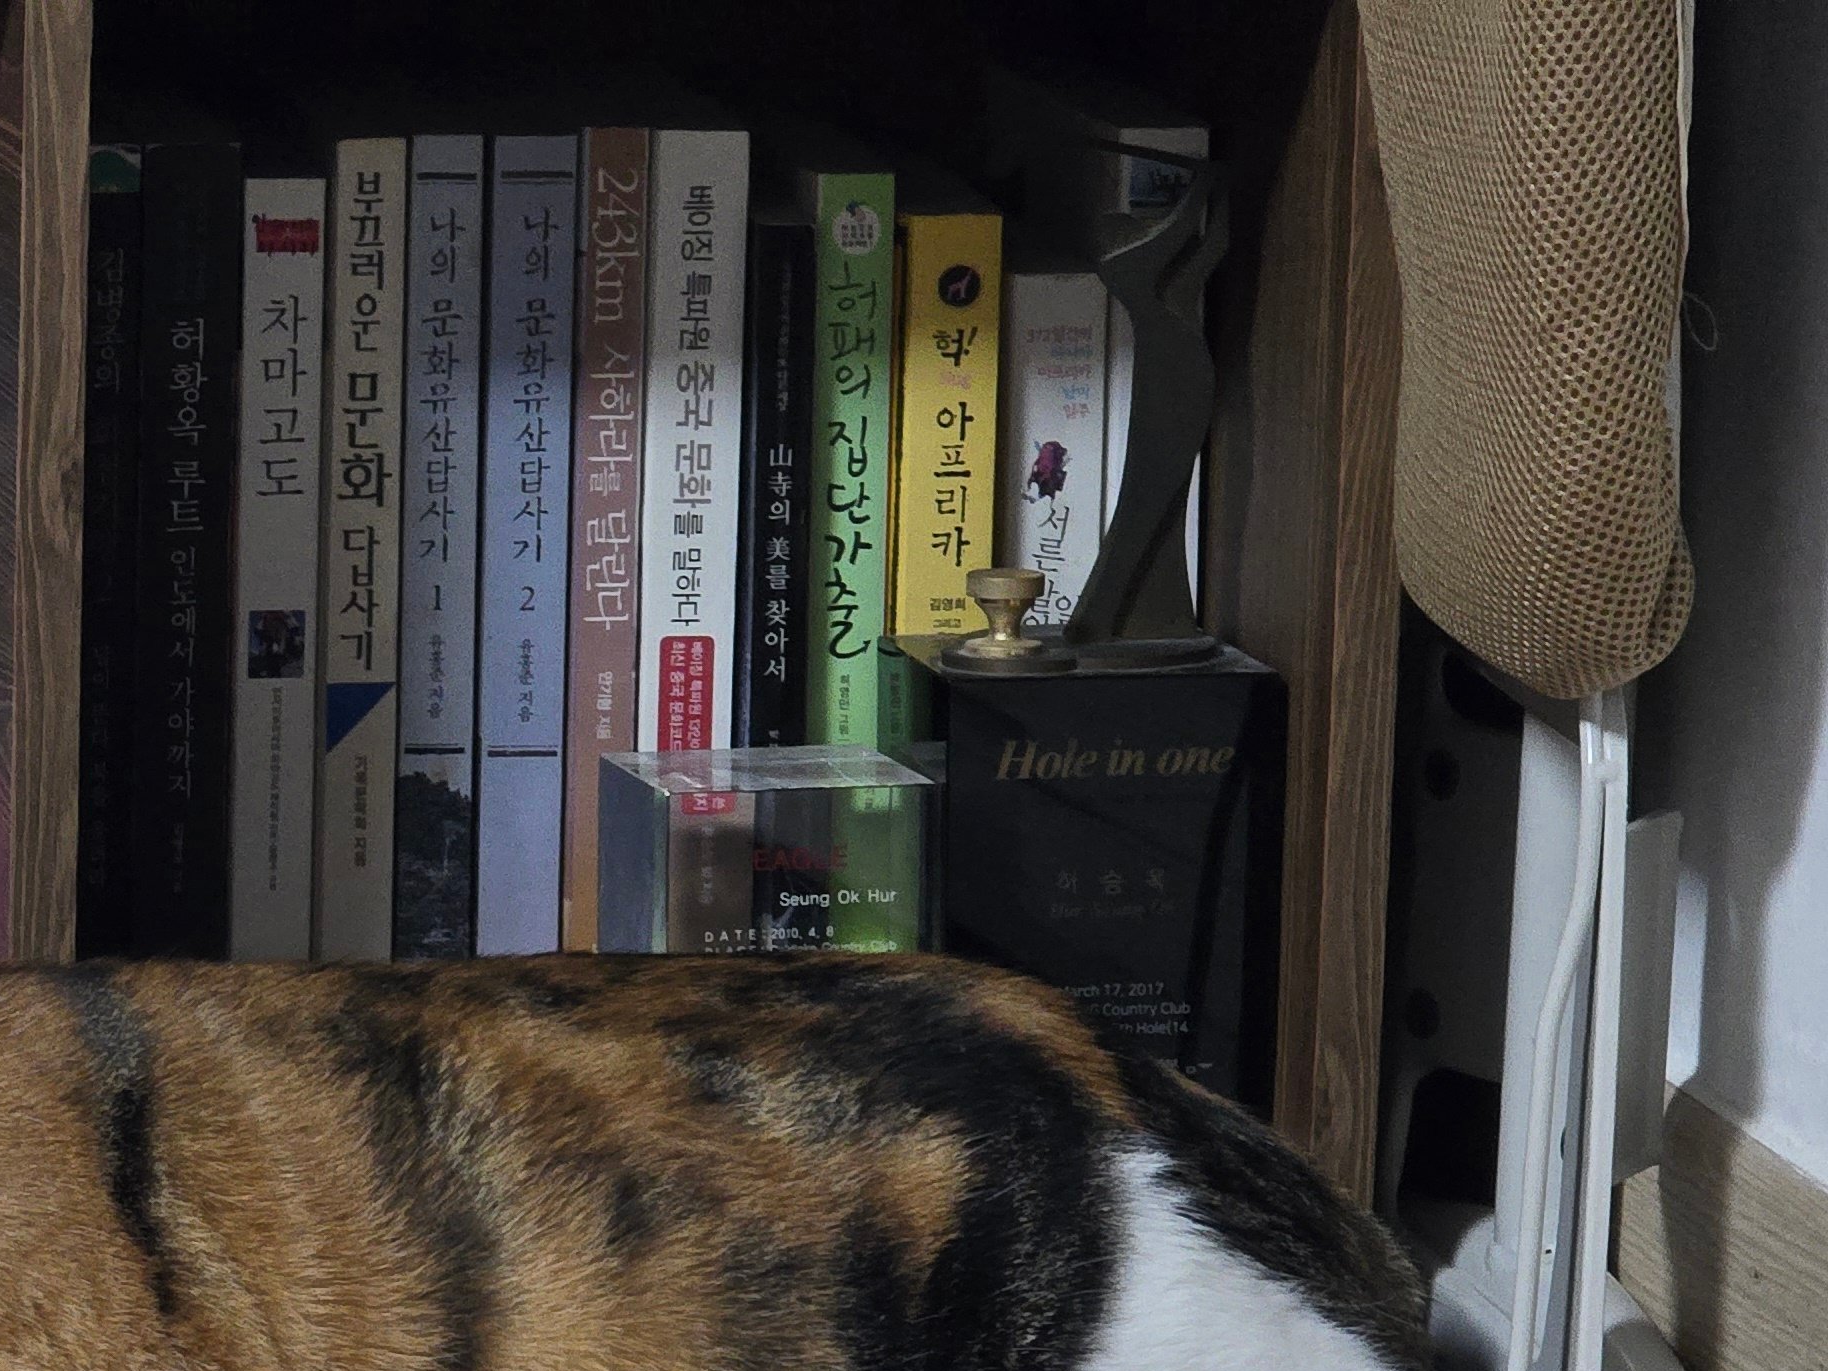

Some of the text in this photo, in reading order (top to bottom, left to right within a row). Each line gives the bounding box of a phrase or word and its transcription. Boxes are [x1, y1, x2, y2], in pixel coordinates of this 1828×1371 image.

[429, 207, 467, 284] 나의
[165, 317, 207, 533] 허황옥 루트
[256, 294, 309, 498] 차마고도
[336, 171, 394, 671] 부끄러운 문화 답사기
[419, 299, 465, 563] 문화유산답사기
[511, 206, 561, 611] 나의 문화유산답사기 2
[582, 168, 640, 630] 243km 사하라를 달린다
[668, 186, 716, 626] 베이징 특파원 중국 문화를 말하다
[767, 444, 794, 525] 山寺의
[930, 402, 975, 567] 아프리카
[669, 671, 684, 697] 중국
[762, 599, 791, 683] 찾아서
[996, 734, 1235, 781] Hole in one
[779, 888, 898, 907] Seung Ok Hur
[1102, 1001, 1192, 1016] Country Club
[1128, 981, 1165, 997] 2017
